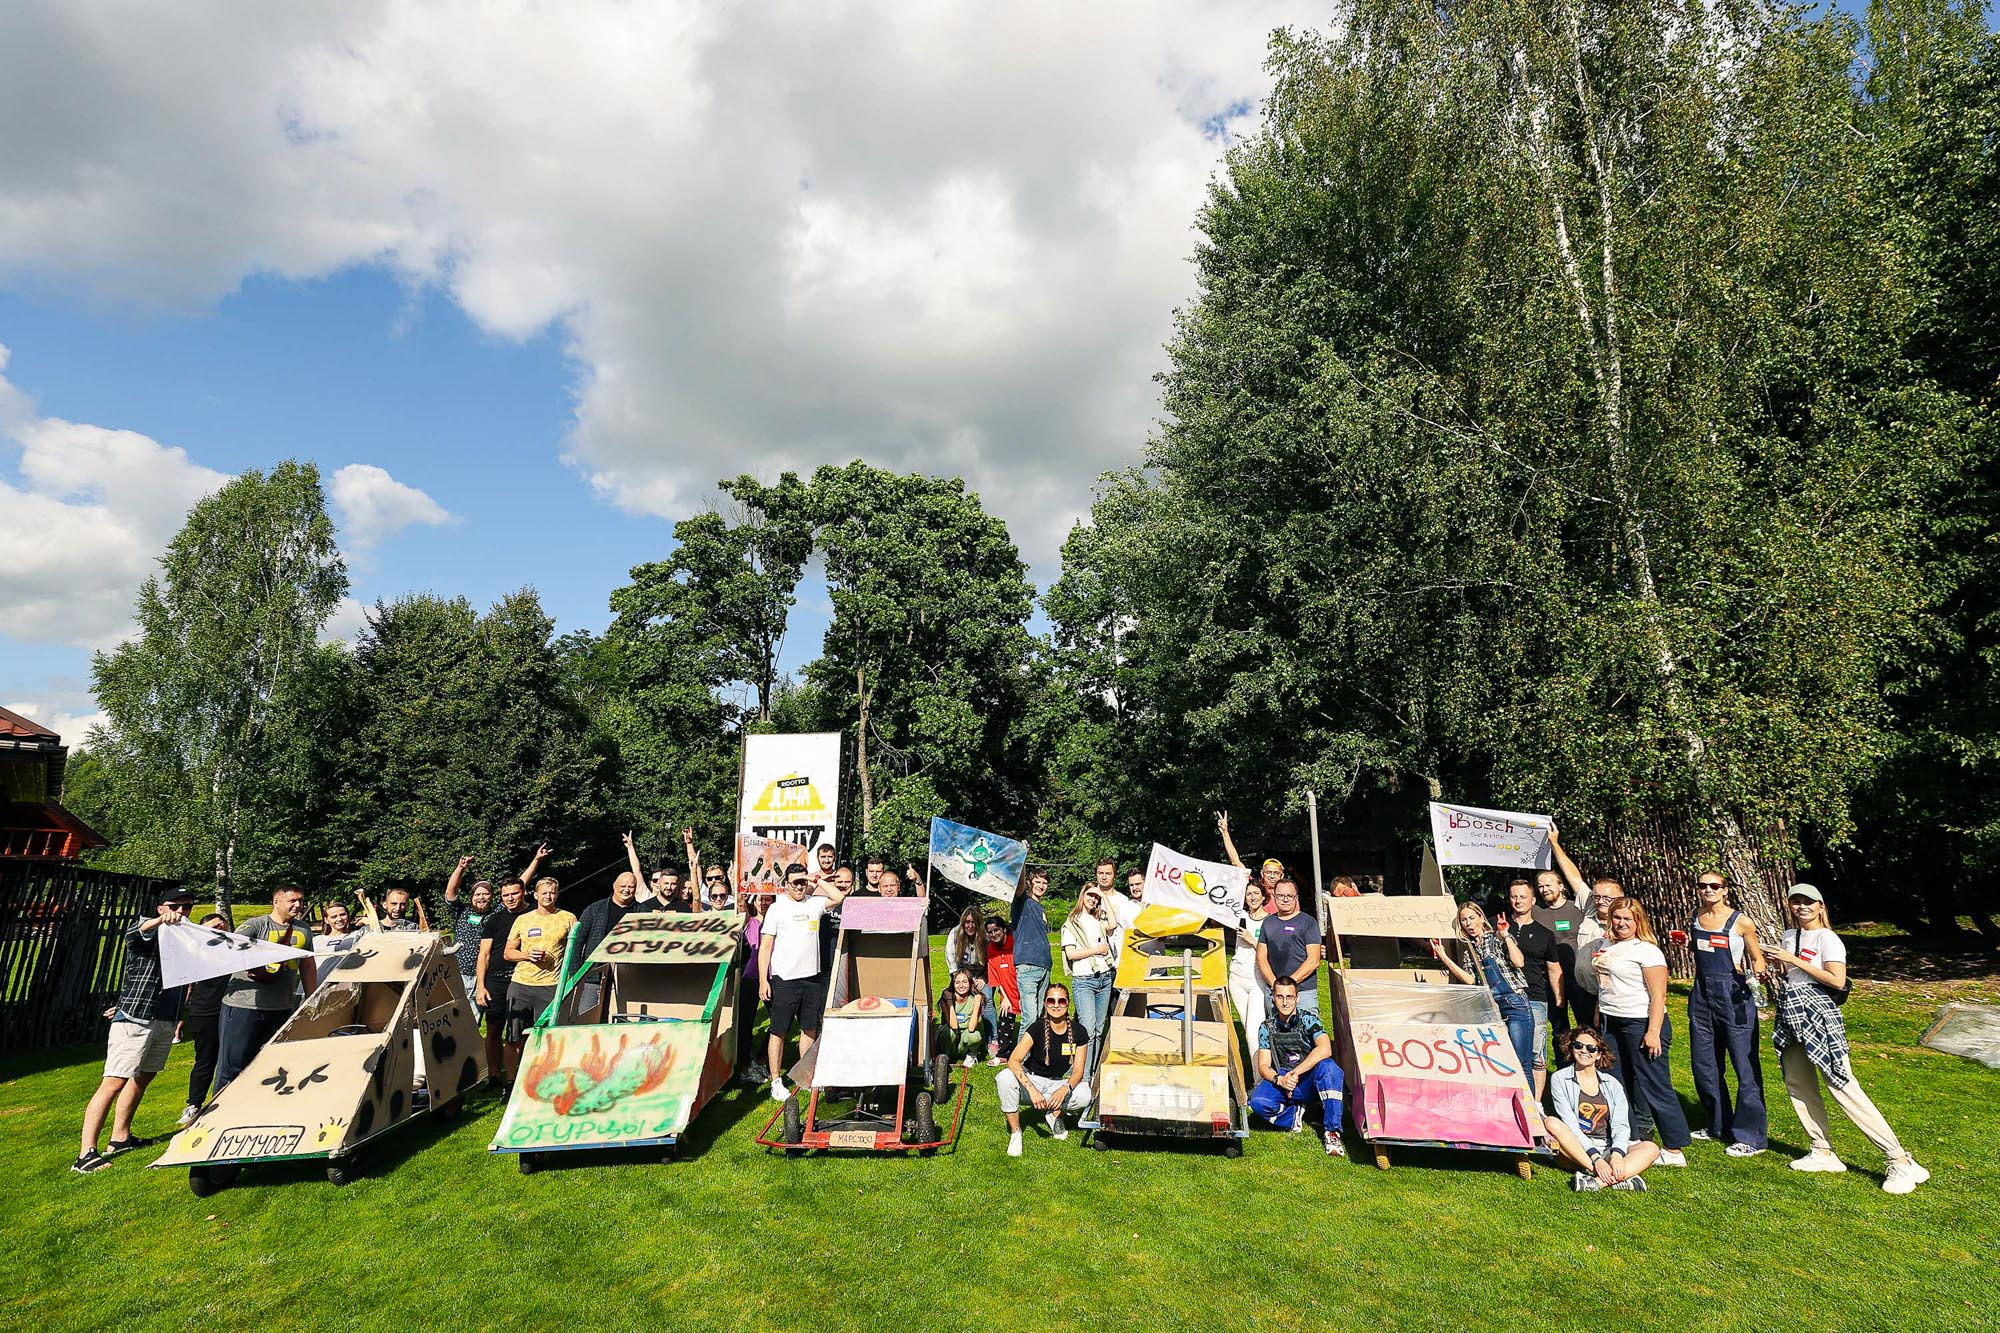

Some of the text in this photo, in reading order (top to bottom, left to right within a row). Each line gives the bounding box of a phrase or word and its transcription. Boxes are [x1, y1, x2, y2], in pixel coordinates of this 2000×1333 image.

[780, 779, 806, 788] RIDOTTO
[605, 940, 737, 958] ОГУРЦЫ
[421, 1013, 452, 1036] DOOR
[508, 1119, 646, 1144] ОГУРЦЫ
